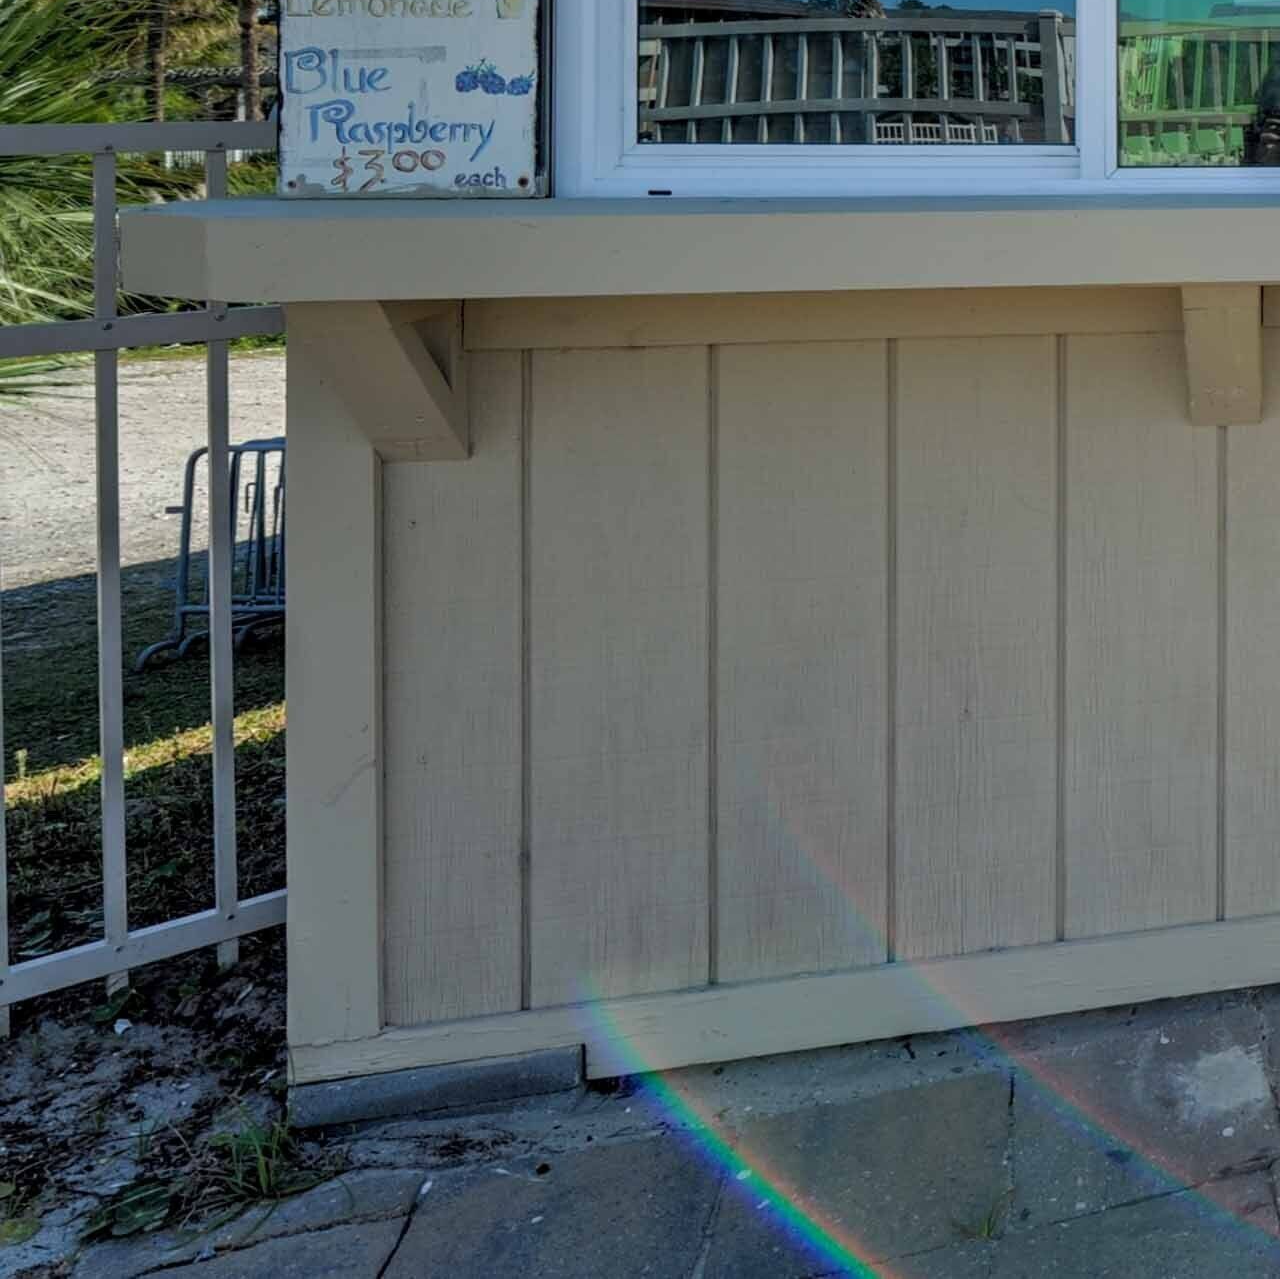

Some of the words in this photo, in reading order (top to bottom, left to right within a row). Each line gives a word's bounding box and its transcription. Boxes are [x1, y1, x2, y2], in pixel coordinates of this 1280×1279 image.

[284, 46, 392, 94] Blue
[305, 99, 496, 162] Raspberry
[454, 167, 507, 189] each
